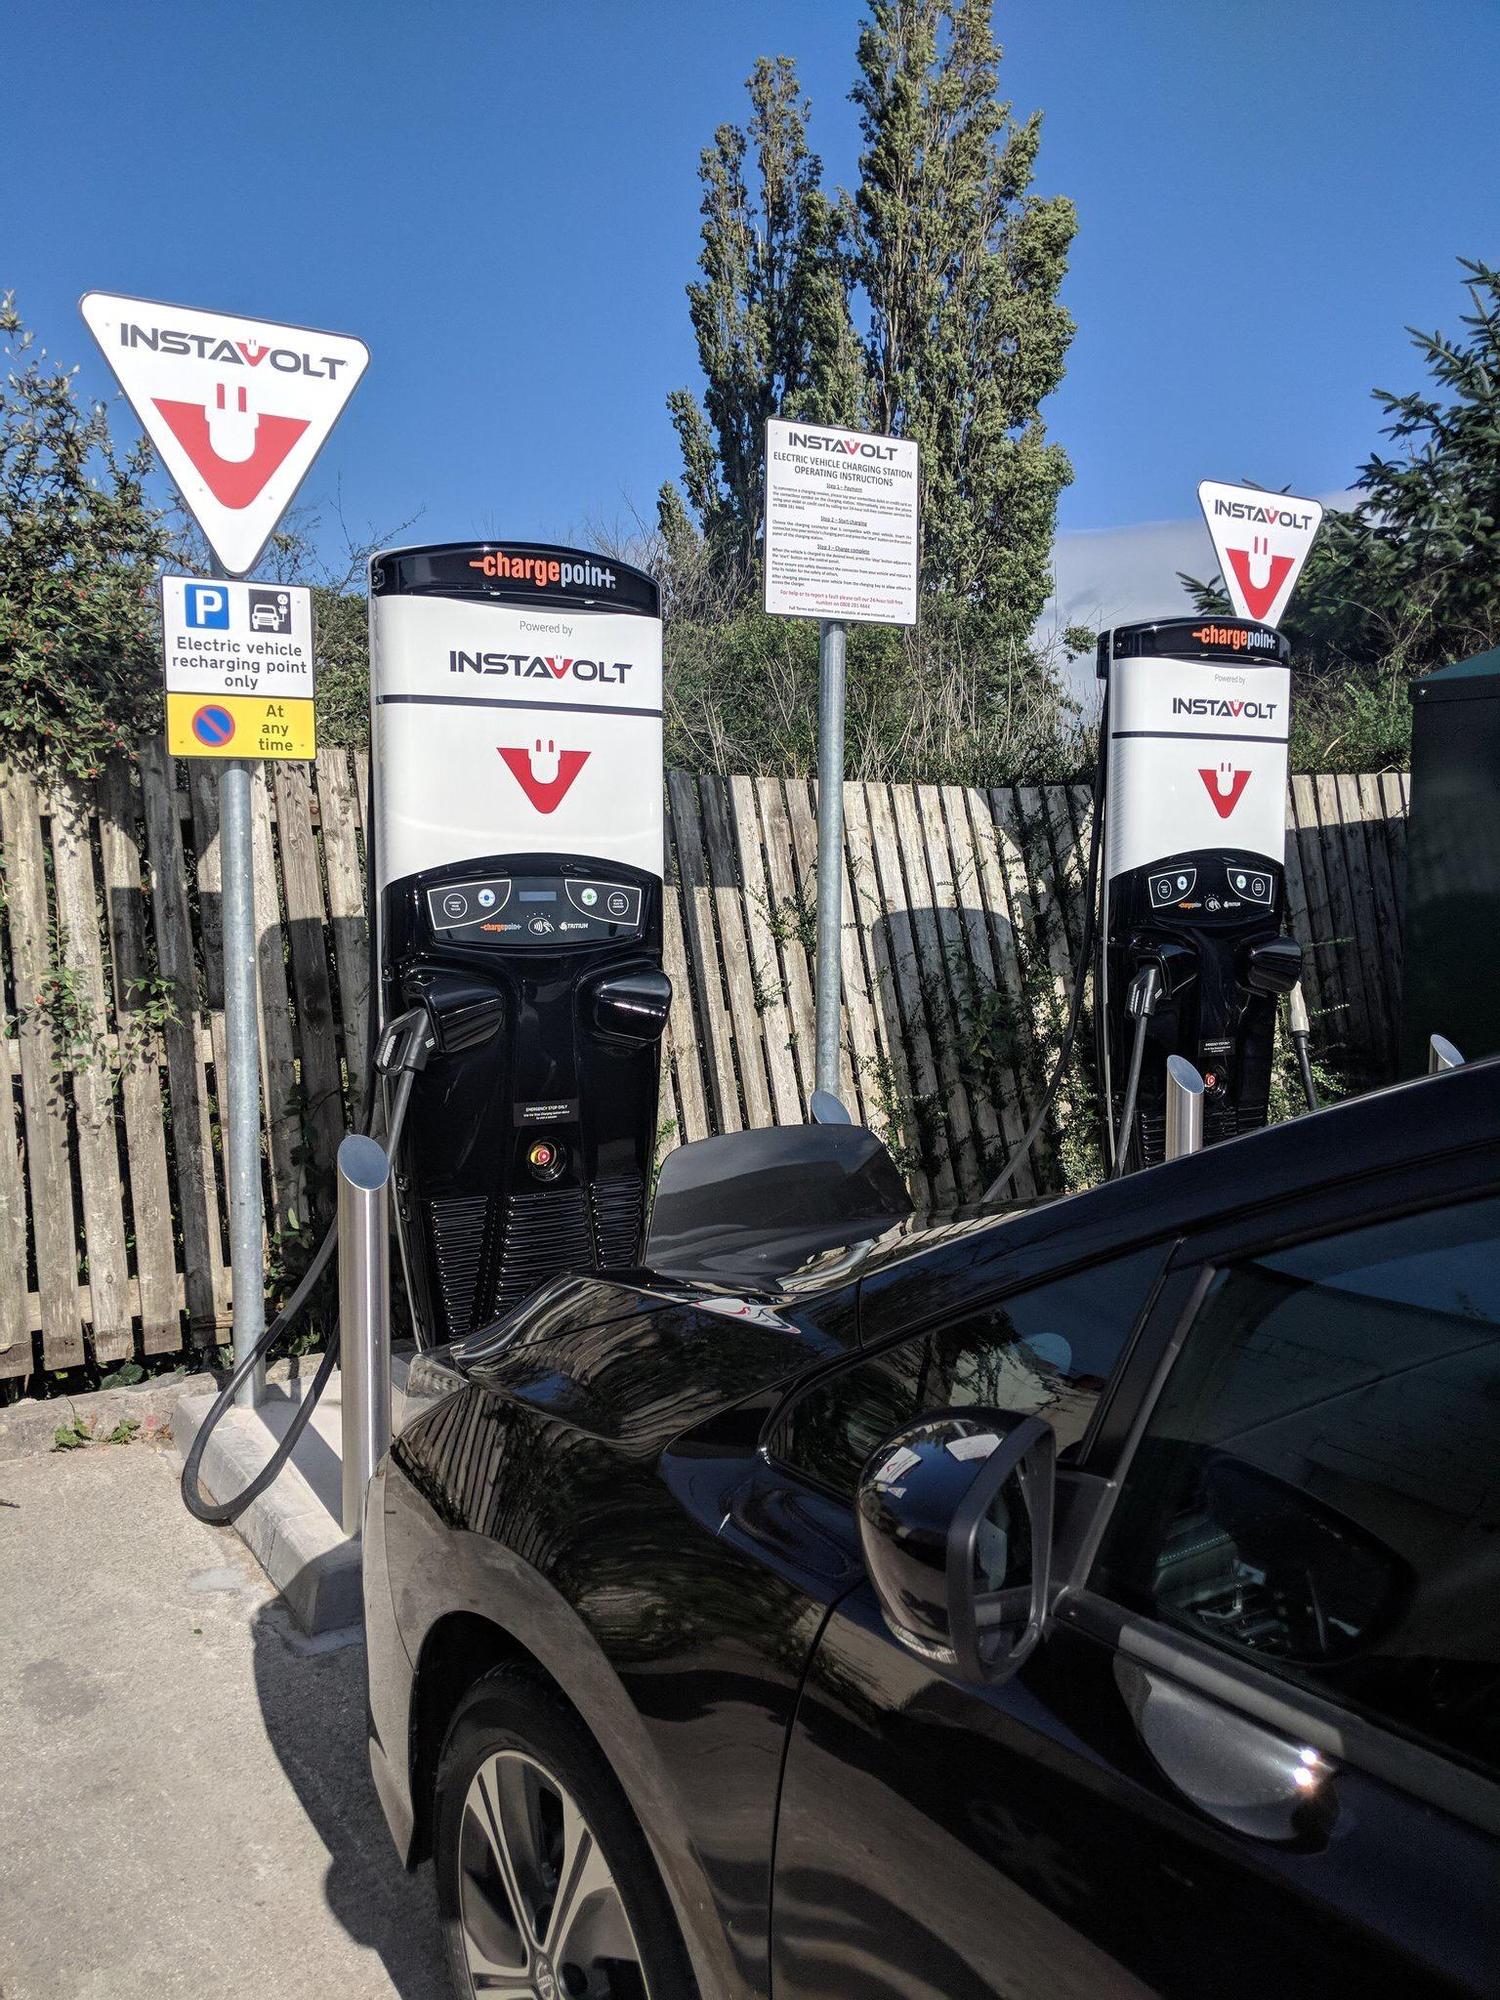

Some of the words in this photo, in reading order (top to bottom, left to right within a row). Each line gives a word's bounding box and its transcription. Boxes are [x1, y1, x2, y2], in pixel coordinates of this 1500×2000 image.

[120, 323, 346, 380] INSTAVOLT
[788, 431, 898, 461] INSTAVOLT
[773, 451, 808, 464] ELECTRIC
[810, 456, 840, 469] VEHICLE
[841, 460, 880, 474] CHARGING
[882, 466, 912, 478] STATION
[794, 465, 837, 479] OPERATING
[839, 471, 893, 486] INSTRUCTIONS
[1214, 499, 1313, 531] INSTAVOLT
[195, 589, 222, 625] P
[519, 620, 560, 634] Powered
[562, 623, 573, 637] by
[177, 637, 241, 653] Electric
[246, 642, 302, 657] vehicle
[172, 656, 260, 673] recharging
[267, 660, 307, 674] point
[450, 650, 632, 684] INSTAVOLT
[224, 675, 258, 690] only
[1214, 673, 1238, 684] Powered
[1238, 675, 1246, 685] by
[266, 704, 284, 718] At
[1172, 697, 1277, 720] INSTAVOLT
[261, 723, 289, 736] any
[259, 739, 293, 751] time
